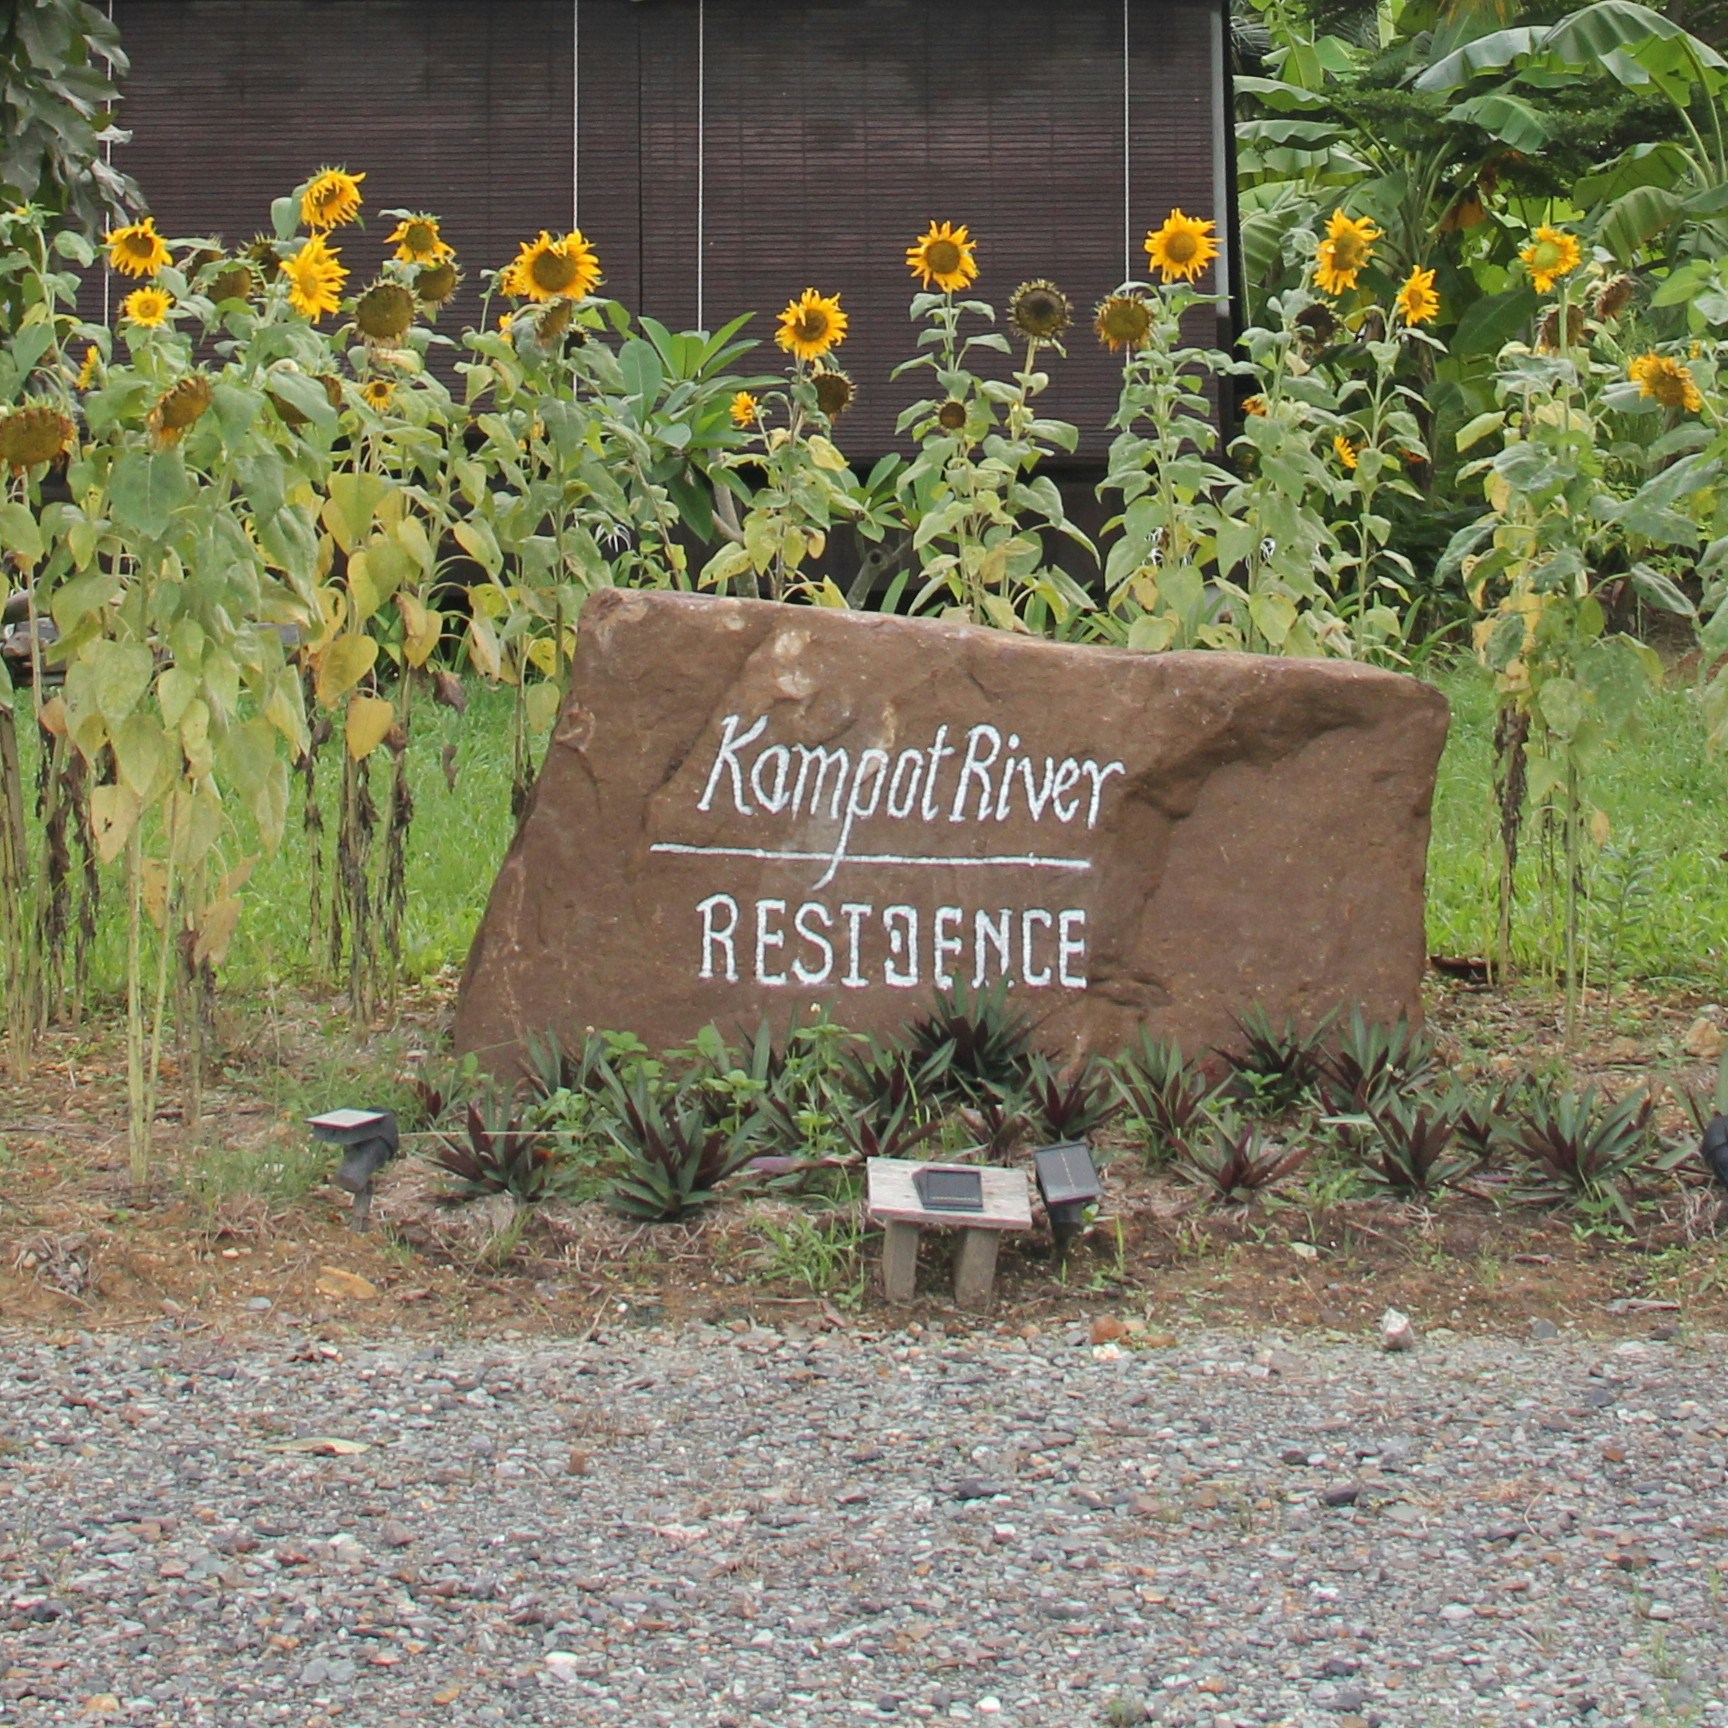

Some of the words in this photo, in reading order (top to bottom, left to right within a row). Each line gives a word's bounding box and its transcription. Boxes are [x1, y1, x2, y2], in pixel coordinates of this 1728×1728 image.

[696, 714, 955, 890] Kampot
[948, 723, 1126, 830] River
[695, 892, 1089, 990] RESIDENCE
